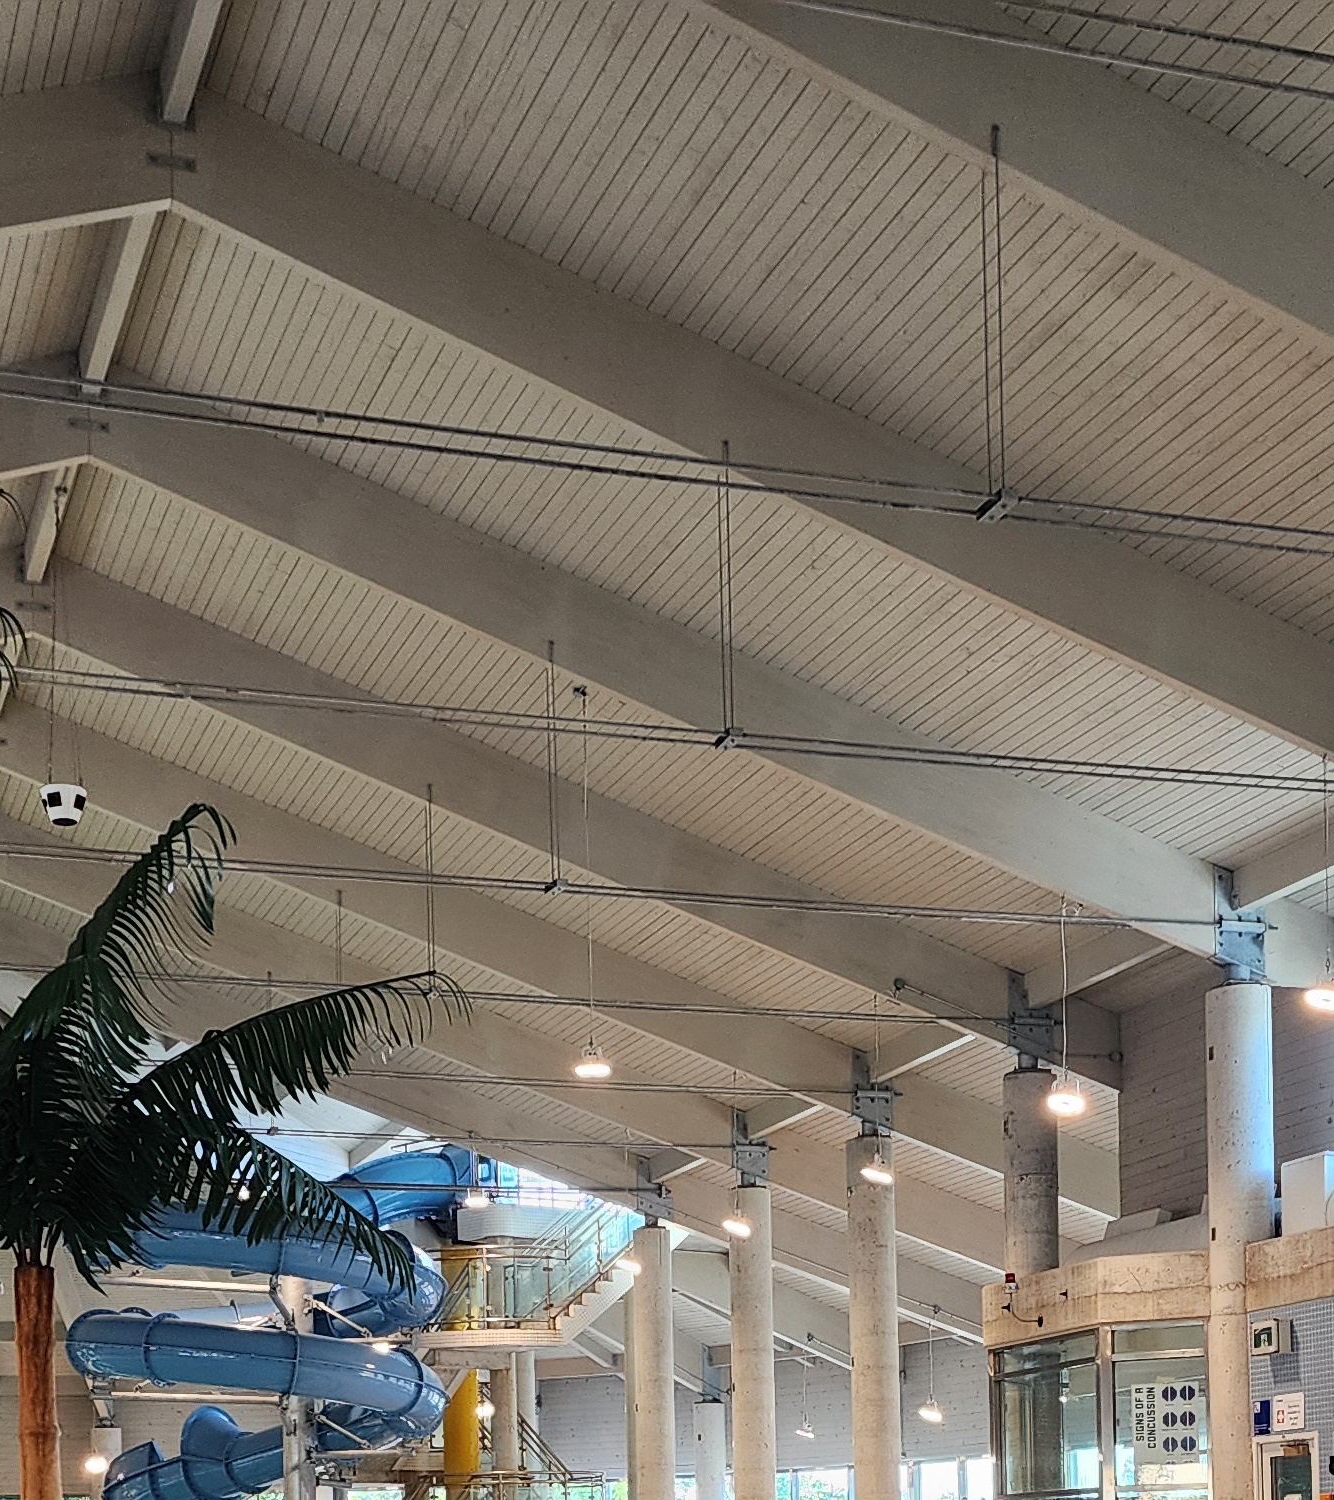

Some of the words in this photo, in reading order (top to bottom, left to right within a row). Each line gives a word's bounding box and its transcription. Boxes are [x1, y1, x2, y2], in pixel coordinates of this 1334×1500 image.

[1135, 1397, 1144, 1410] OF
[1146, 1386, 1156, 1449] CONCUSSION
[1135, 1412, 1145, 1442] SIGNS
